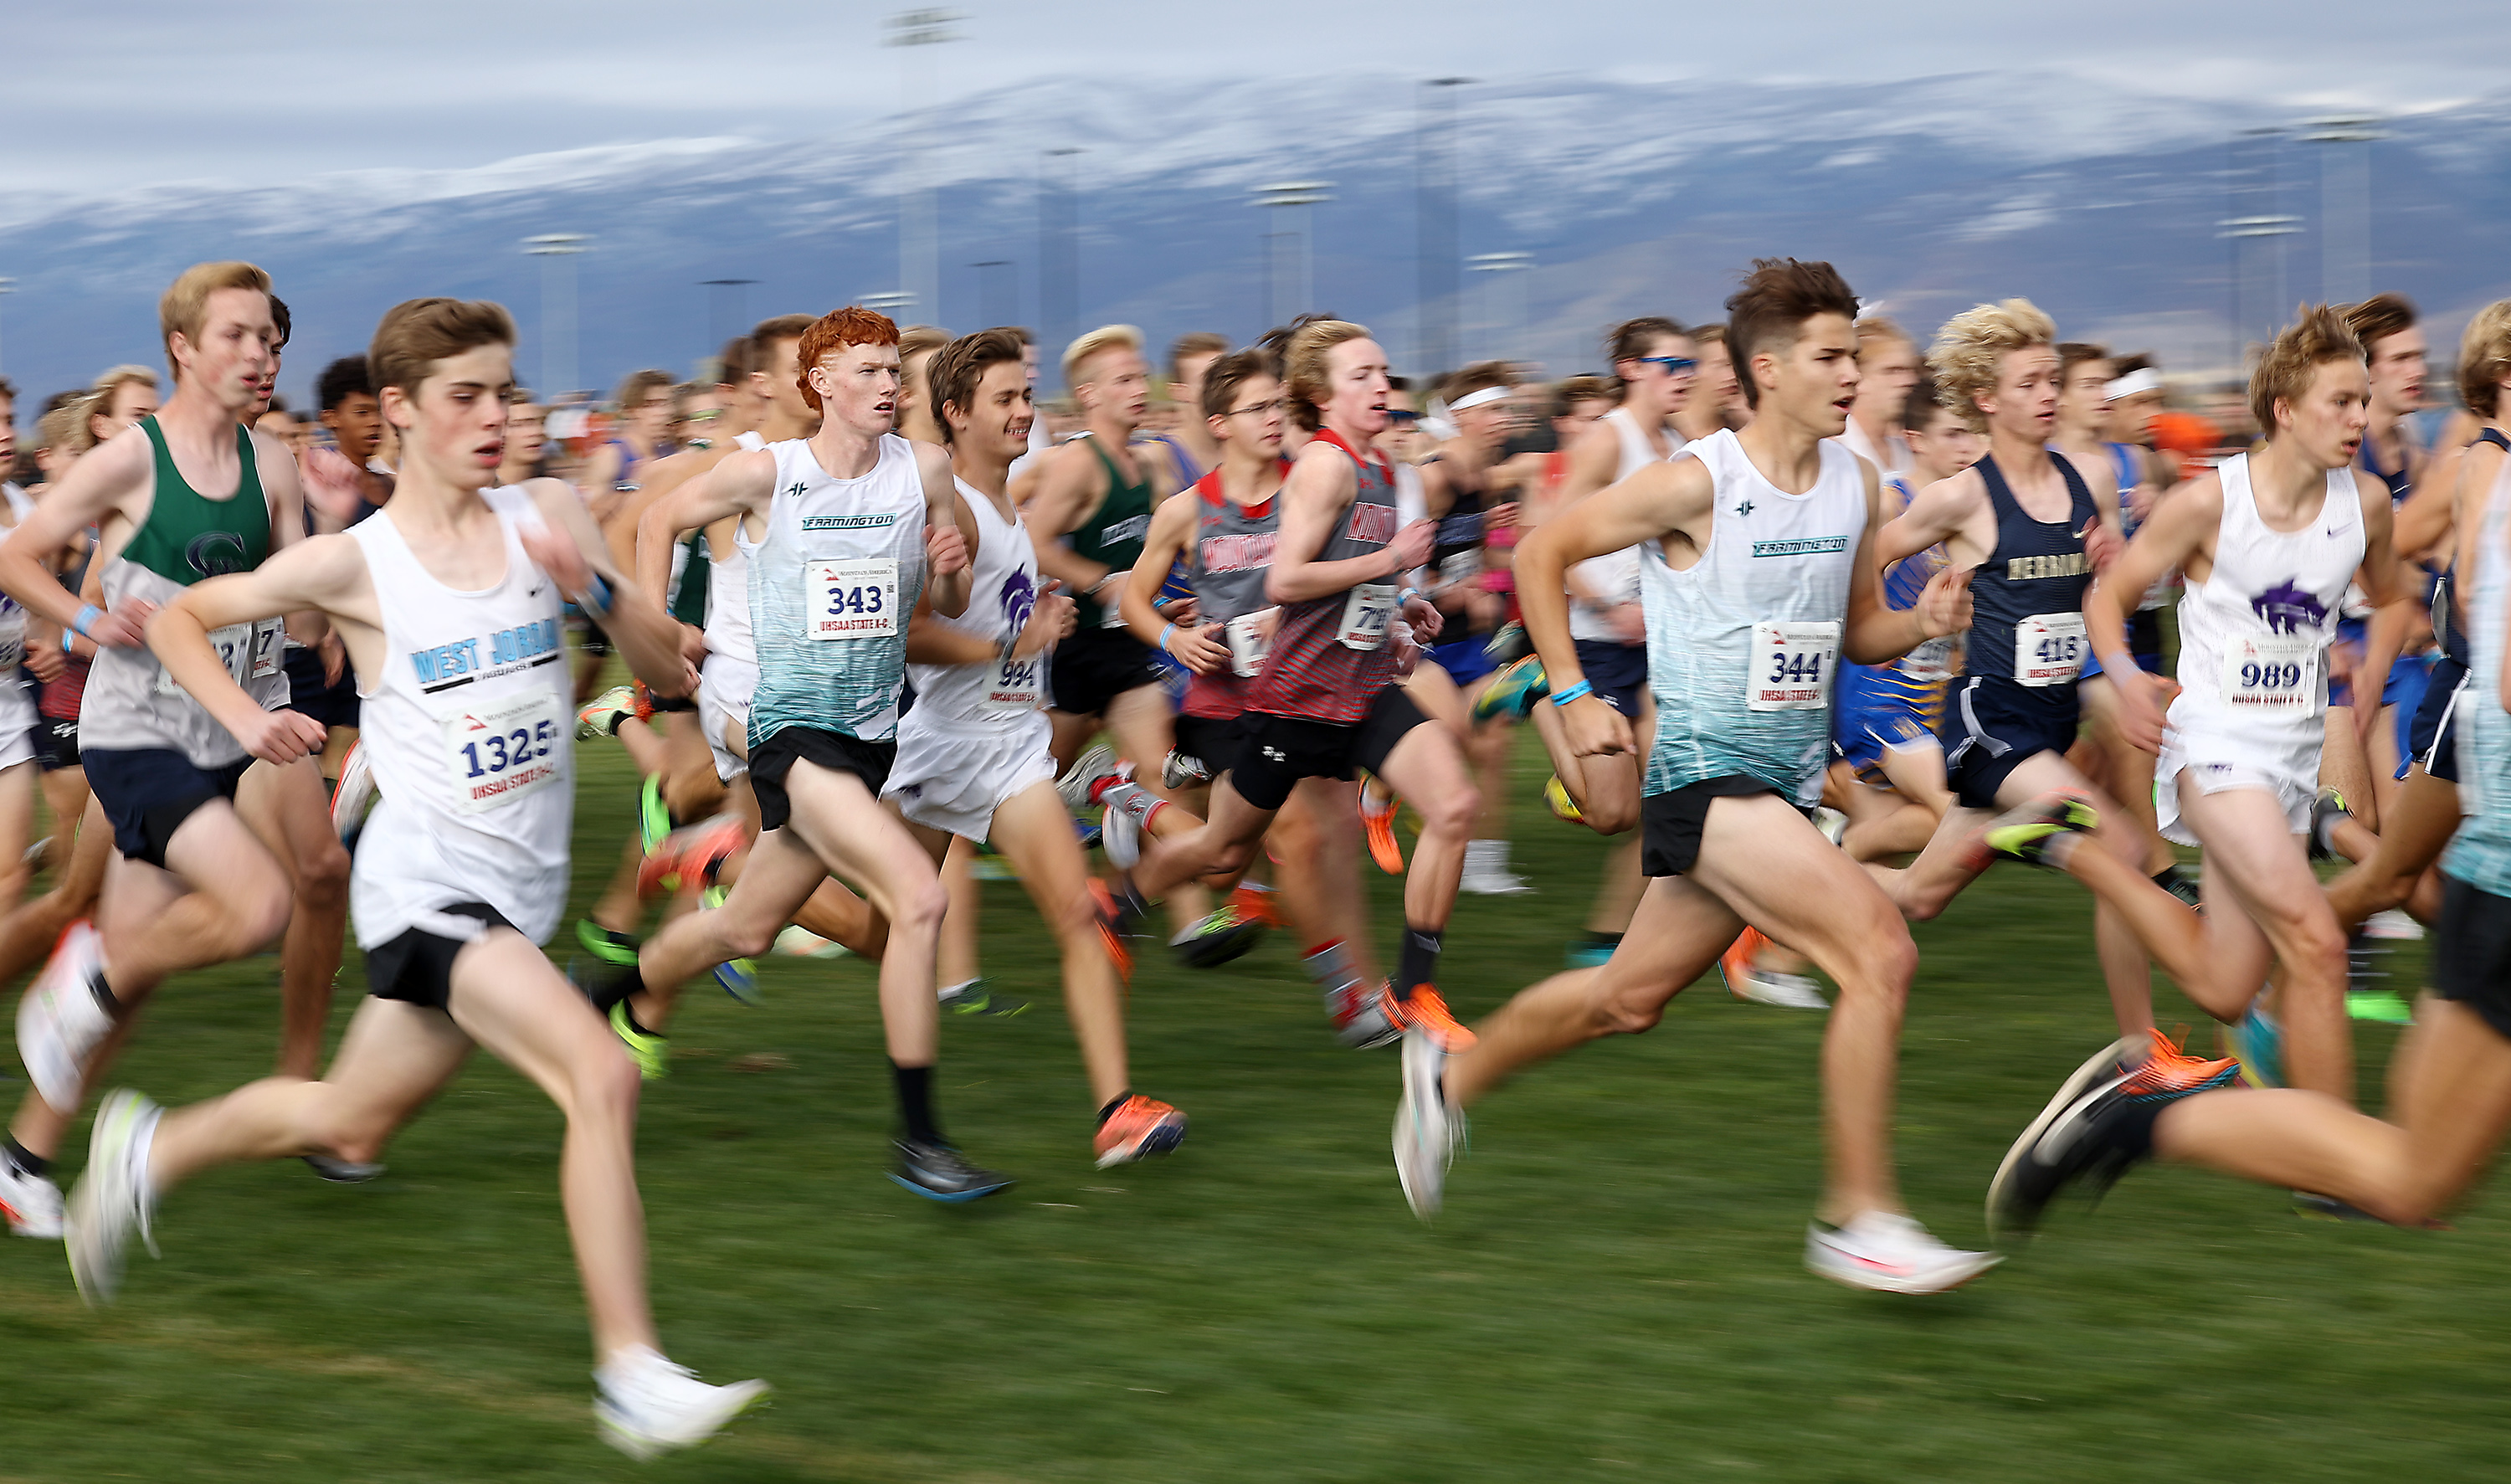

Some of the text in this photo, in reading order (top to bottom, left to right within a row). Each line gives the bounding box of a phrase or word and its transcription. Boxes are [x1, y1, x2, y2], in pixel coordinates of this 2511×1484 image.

[806, 515, 894, 527] FARMINGTON
[1758, 538, 1847, 552] FARMINGTON
[827, 586, 882, 615] 343
[819, 620, 850, 631] UHSAA
[851, 619, 874, 629] STATE
[409, 638, 480, 684] WEST
[998, 660, 1035, 687] 994
[1769, 653, 1820, 683] 344
[2241, 661, 2301, 687] 989
[2232, 693, 2262, 707] UHSAA
[2263, 693, 2288, 707] STATE
[461, 719, 553, 778] 1325
